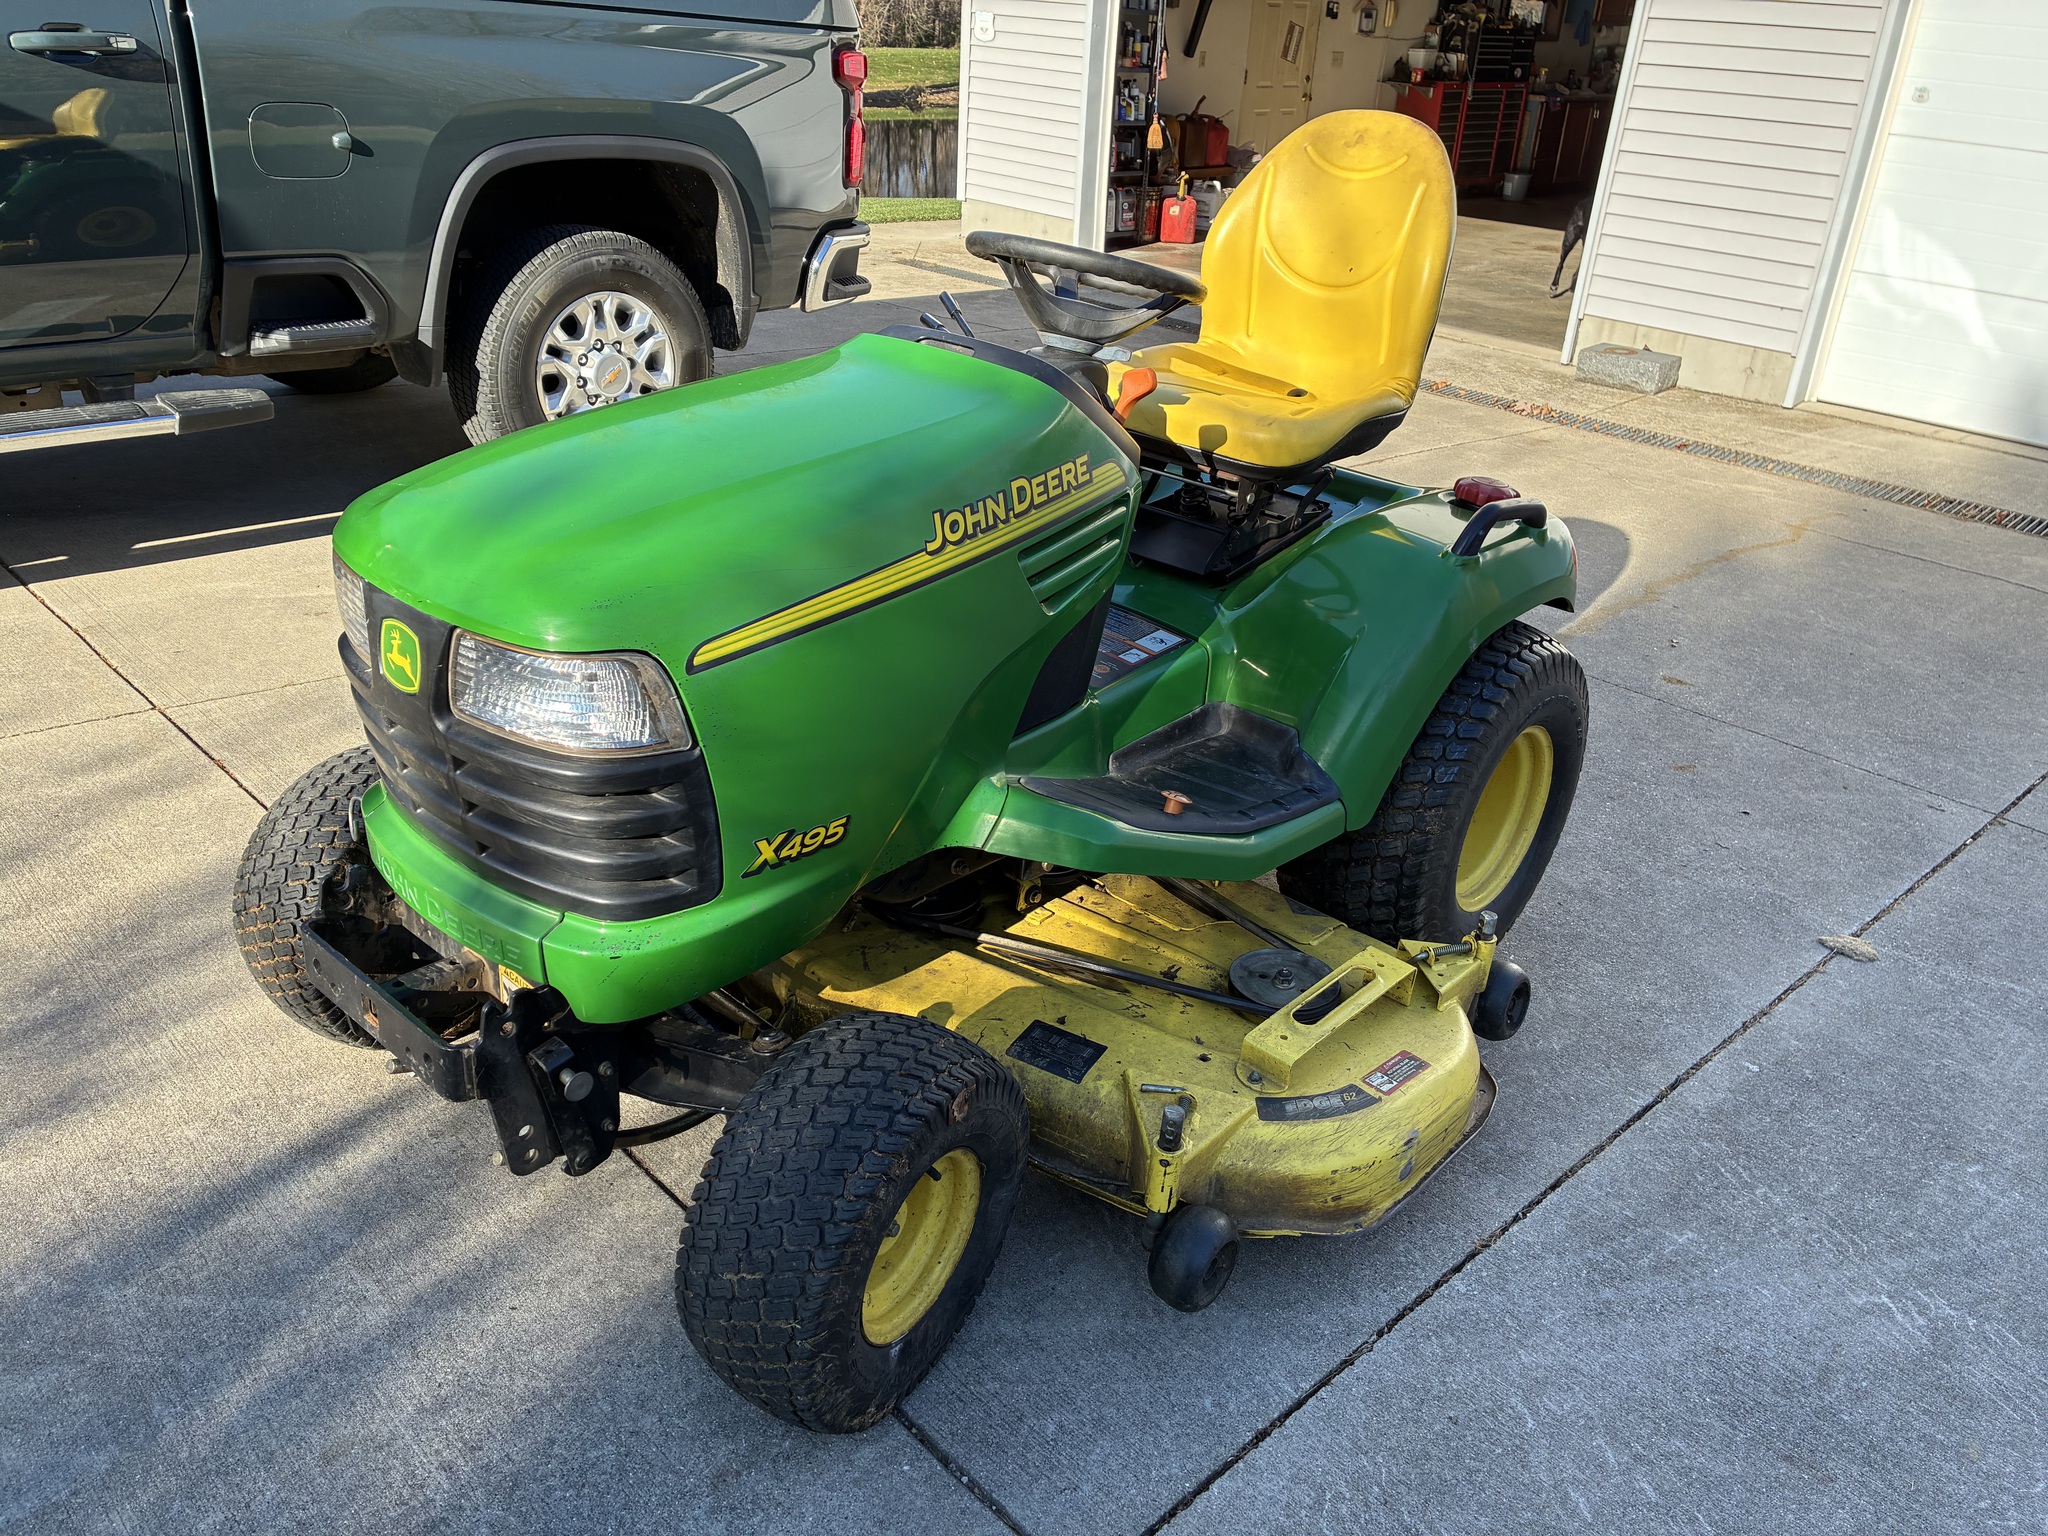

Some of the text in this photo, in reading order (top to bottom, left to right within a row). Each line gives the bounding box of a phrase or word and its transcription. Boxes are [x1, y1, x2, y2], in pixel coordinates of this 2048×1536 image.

[925, 453, 1092, 555] JOHN DEERE
[743, 814, 850, 877] X495
[376, 852, 523, 970] JOHN DEERE
[1282, 1093, 1345, 1115] EDGE
[1343, 1091, 1357, 1102] 62
